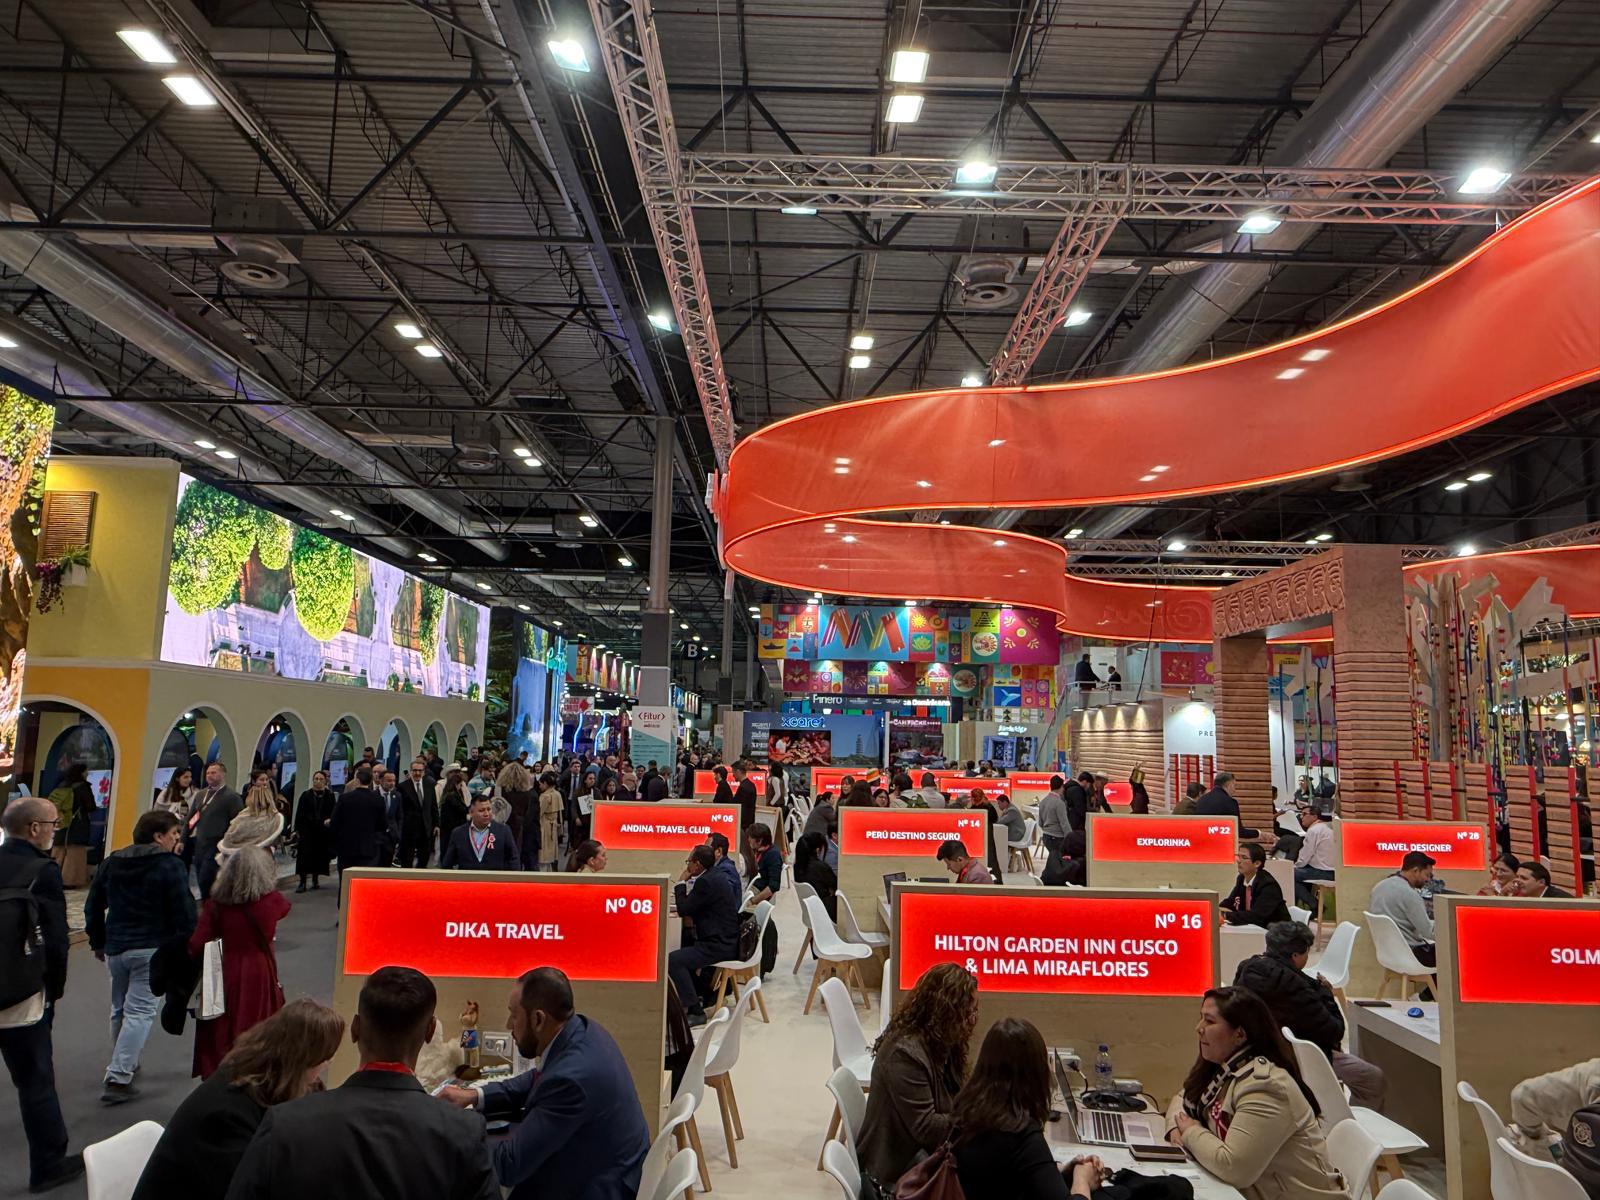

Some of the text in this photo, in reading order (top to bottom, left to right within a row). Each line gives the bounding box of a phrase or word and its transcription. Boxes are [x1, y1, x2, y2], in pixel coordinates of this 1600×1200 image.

[688, 643, 698, 658] B
[711, 813, 722, 822] Nº
[620, 824, 711, 834] ANDINA TRAVEL CLUB
[958, 819, 981, 828] Nº 14
[865, 830, 961, 841] PERÚ DESTINO SEGURO
[1208, 826, 1231, 835] Nº 22
[1456, 831, 1480, 840] Nº 28
[1136, 838, 1191, 847] EXPLORINKA
[1376, 842, 1452, 852] TRAVEL DESIGNER
[605, 897, 653, 915] Nº 08
[1155, 912, 1202, 929] Nº 16
[445, 921, 564, 940] DIKA TRAVEL
[934, 935, 1179, 956] HILTON GARDEN INN CUSCO
[1550, 948, 1600, 965] SOLM
[965, 957, 1149, 977] & LIMA MIRAFLORES
